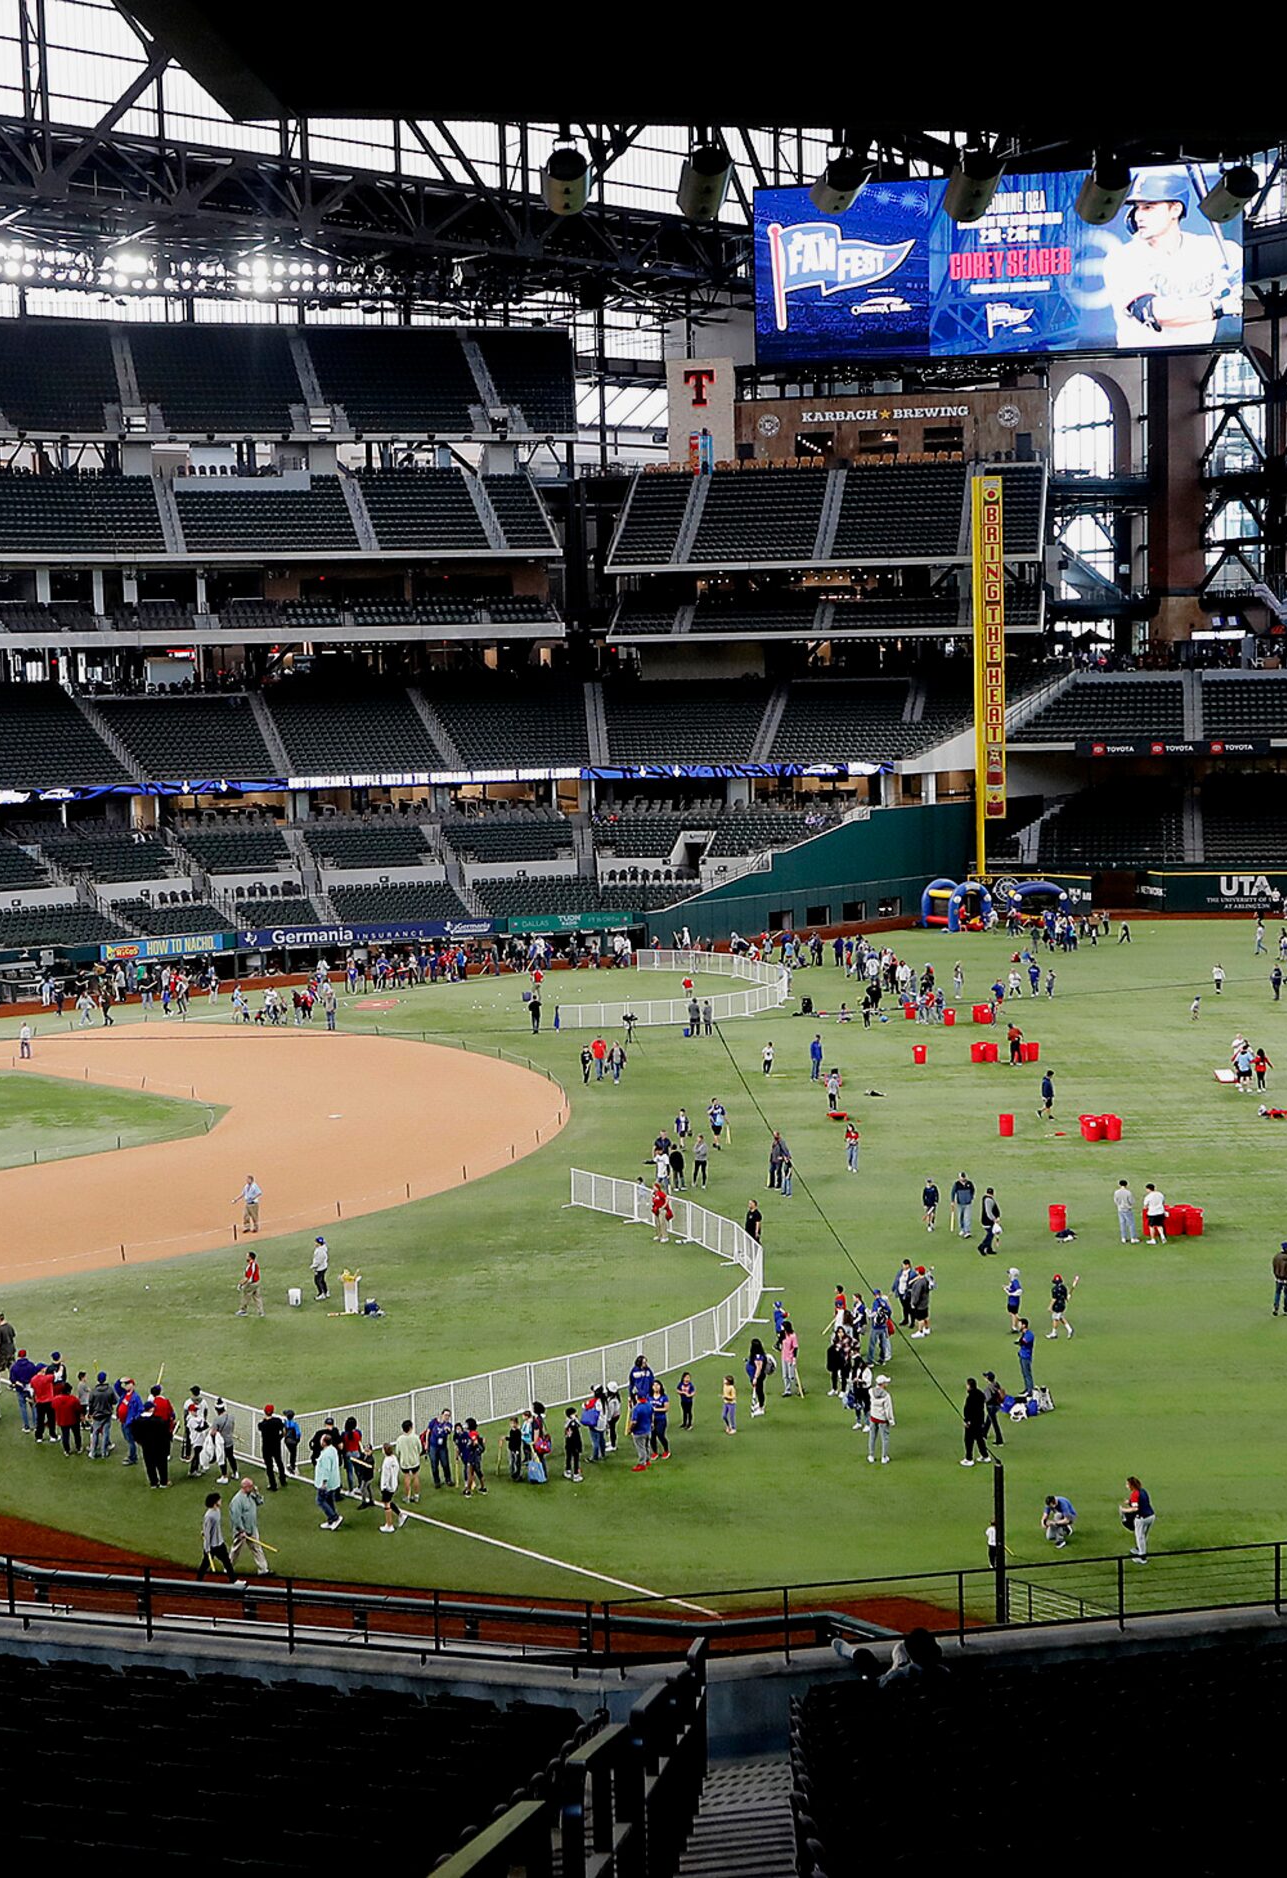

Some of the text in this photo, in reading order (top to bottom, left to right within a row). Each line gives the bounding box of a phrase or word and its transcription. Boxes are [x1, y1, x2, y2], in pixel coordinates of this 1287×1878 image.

[788, 237, 836, 275] FAN
[949, 247, 1072, 280] COREY SEAGER
[683, 368, 715, 407] T
[801, 406, 969, 423] KARBACH BREWING
[986, 507, 998, 599] BRING
[988, 608, 999, 661] THE
[989, 668, 1000, 742] HEAT
[1220, 876, 1272, 896] UTA
[272, 928, 425, 944] Germania INSURANCE
[521, 920, 548, 928] DALLAS
[146, 941, 169, 956] HOW
[171, 938, 181, 953] TO
